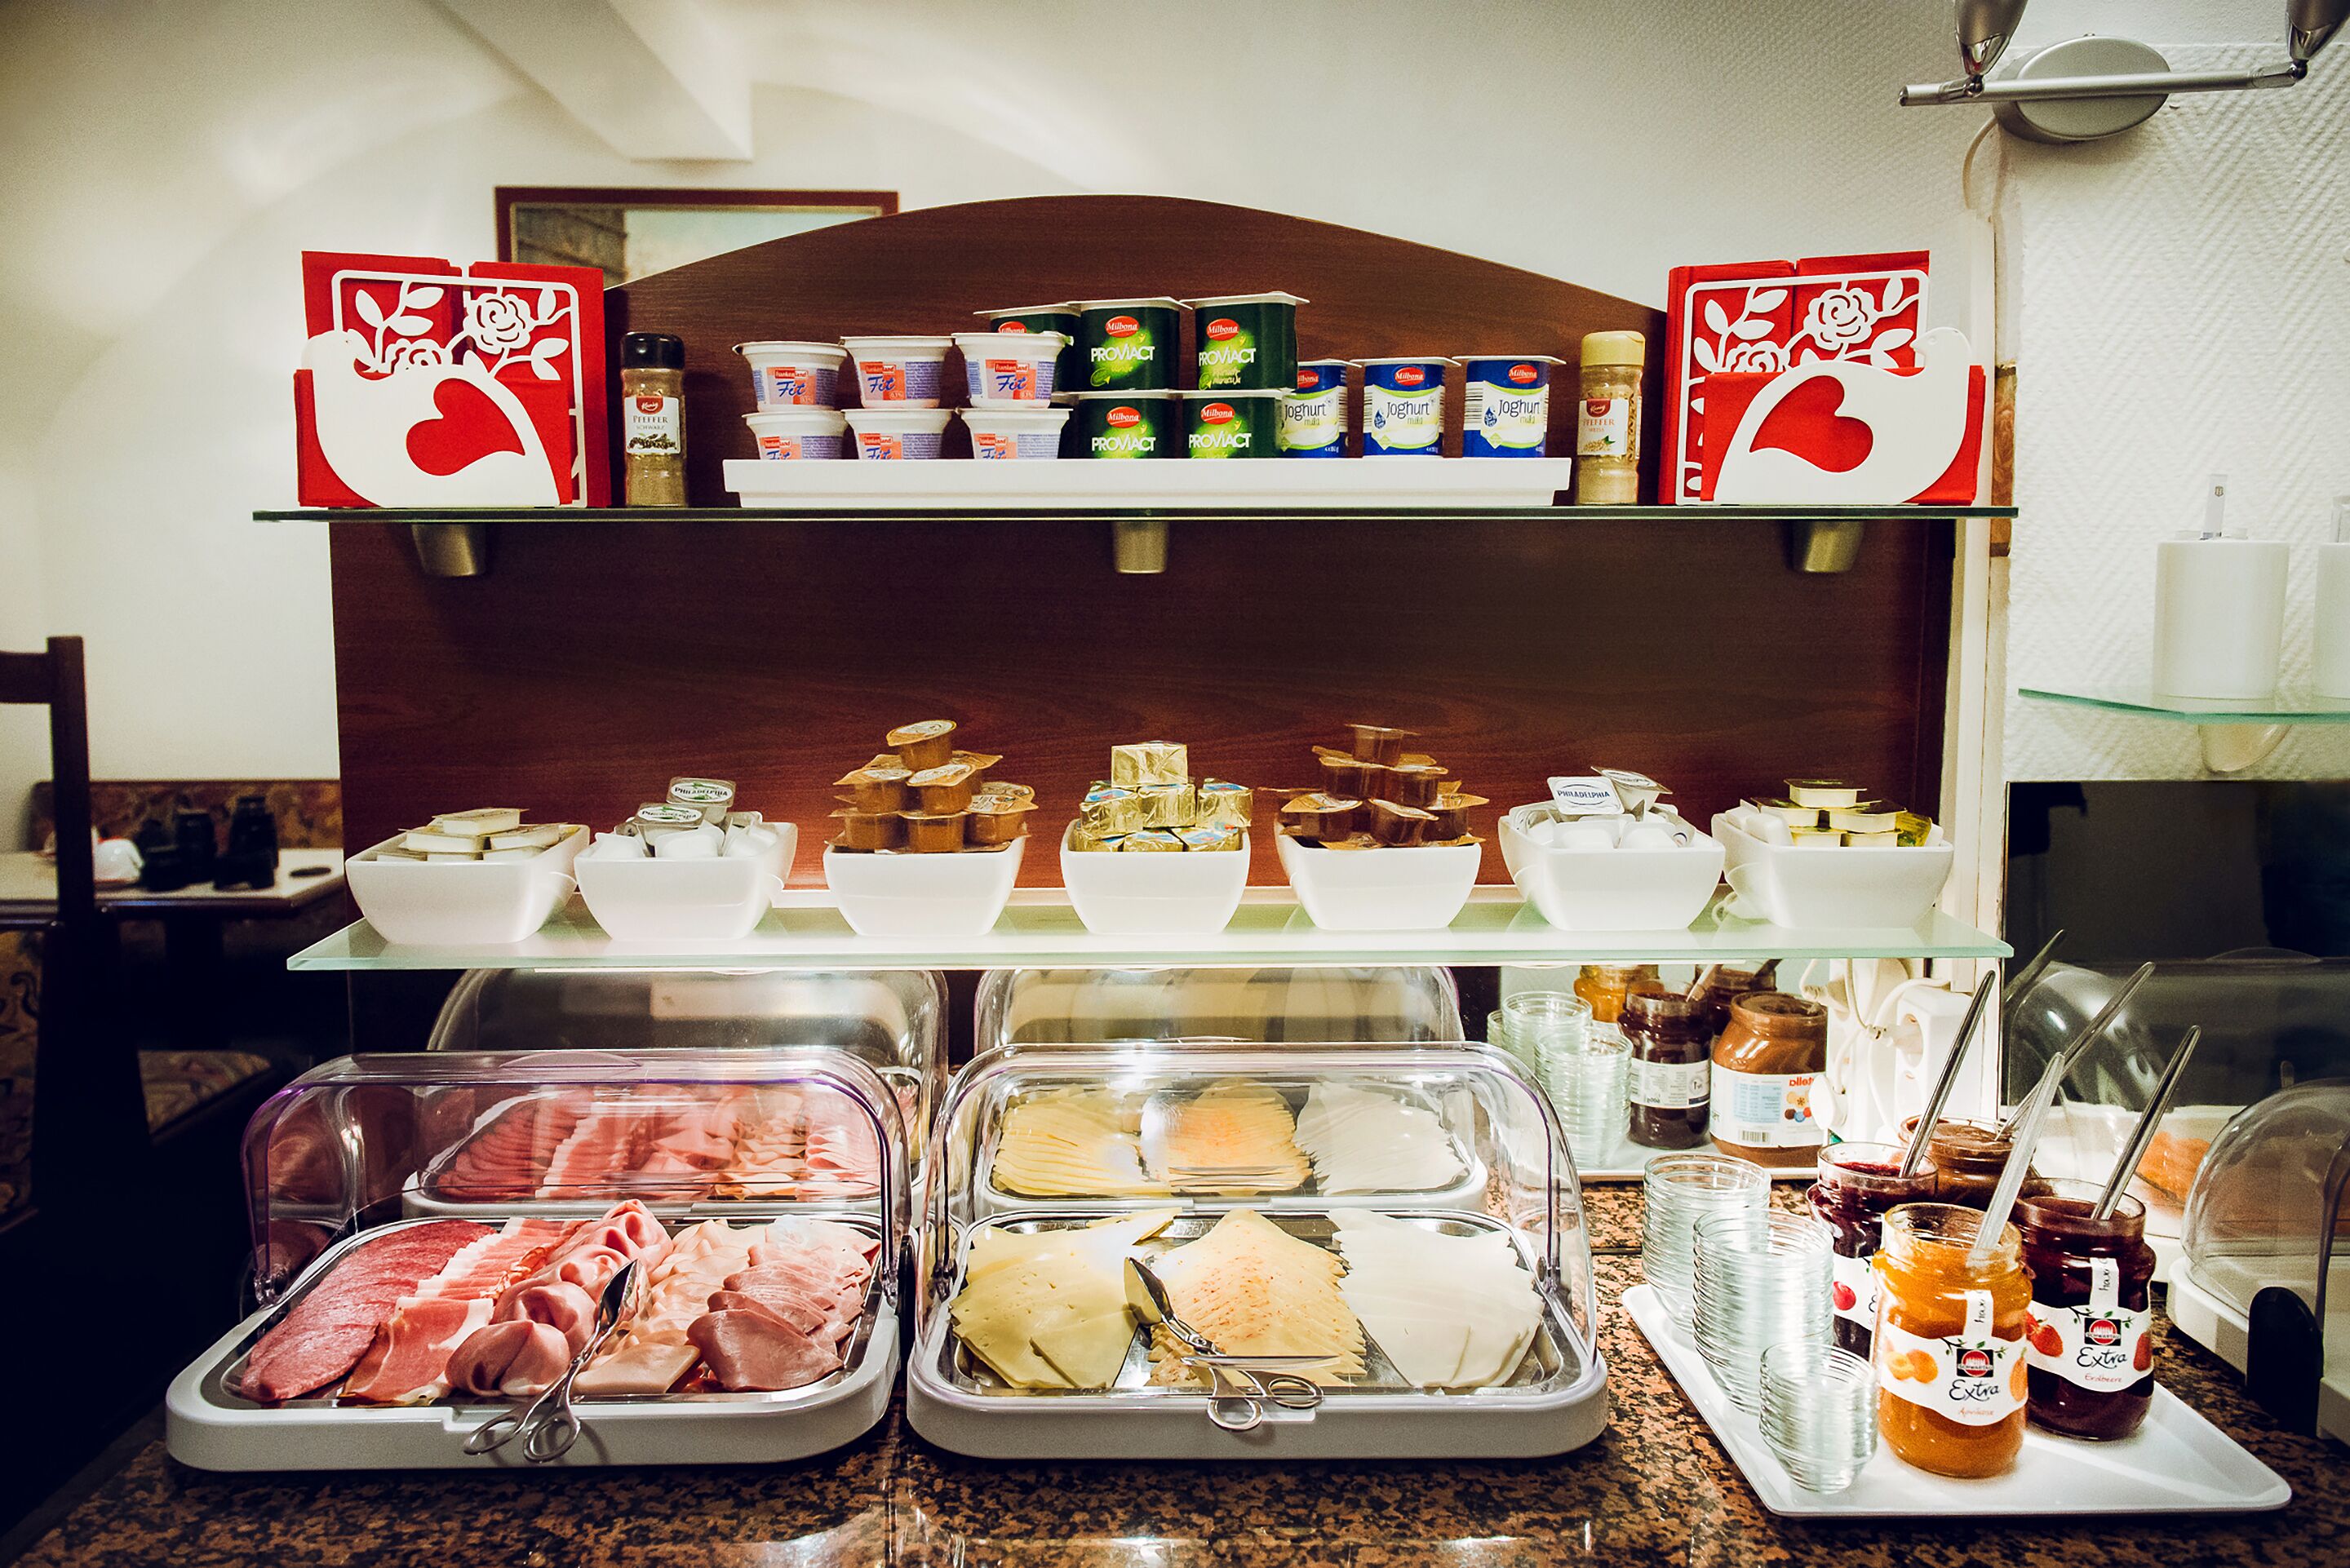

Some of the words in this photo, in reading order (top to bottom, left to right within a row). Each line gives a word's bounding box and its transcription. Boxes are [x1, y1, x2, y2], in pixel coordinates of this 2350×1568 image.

[1107, 322, 1138, 330] Milbona
[1208, 325, 1239, 334] Milbona
[1395, 372, 1424, 380] Milbona
[1510, 369, 1537, 378] Milbona
[867, 376, 895, 392] Fit
[995, 374, 1027, 392] Fit
[776, 380, 806, 397] Fit
[1202, 409, 1233, 417] Milbona
[1284, 403, 1326, 421] Joghurt
[1386, 401, 1430, 419] Joghurt
[632, 414, 668, 423] PFEFFER
[1109, 413, 1139, 421] Milbona
[674, 786, 729, 797] PHILADELPHIA
[1557, 790, 1611, 798] PHILADELPHIA
[2077, 1347, 2128, 1370] Extra
[1949, 1379, 2000, 1402] Extra
